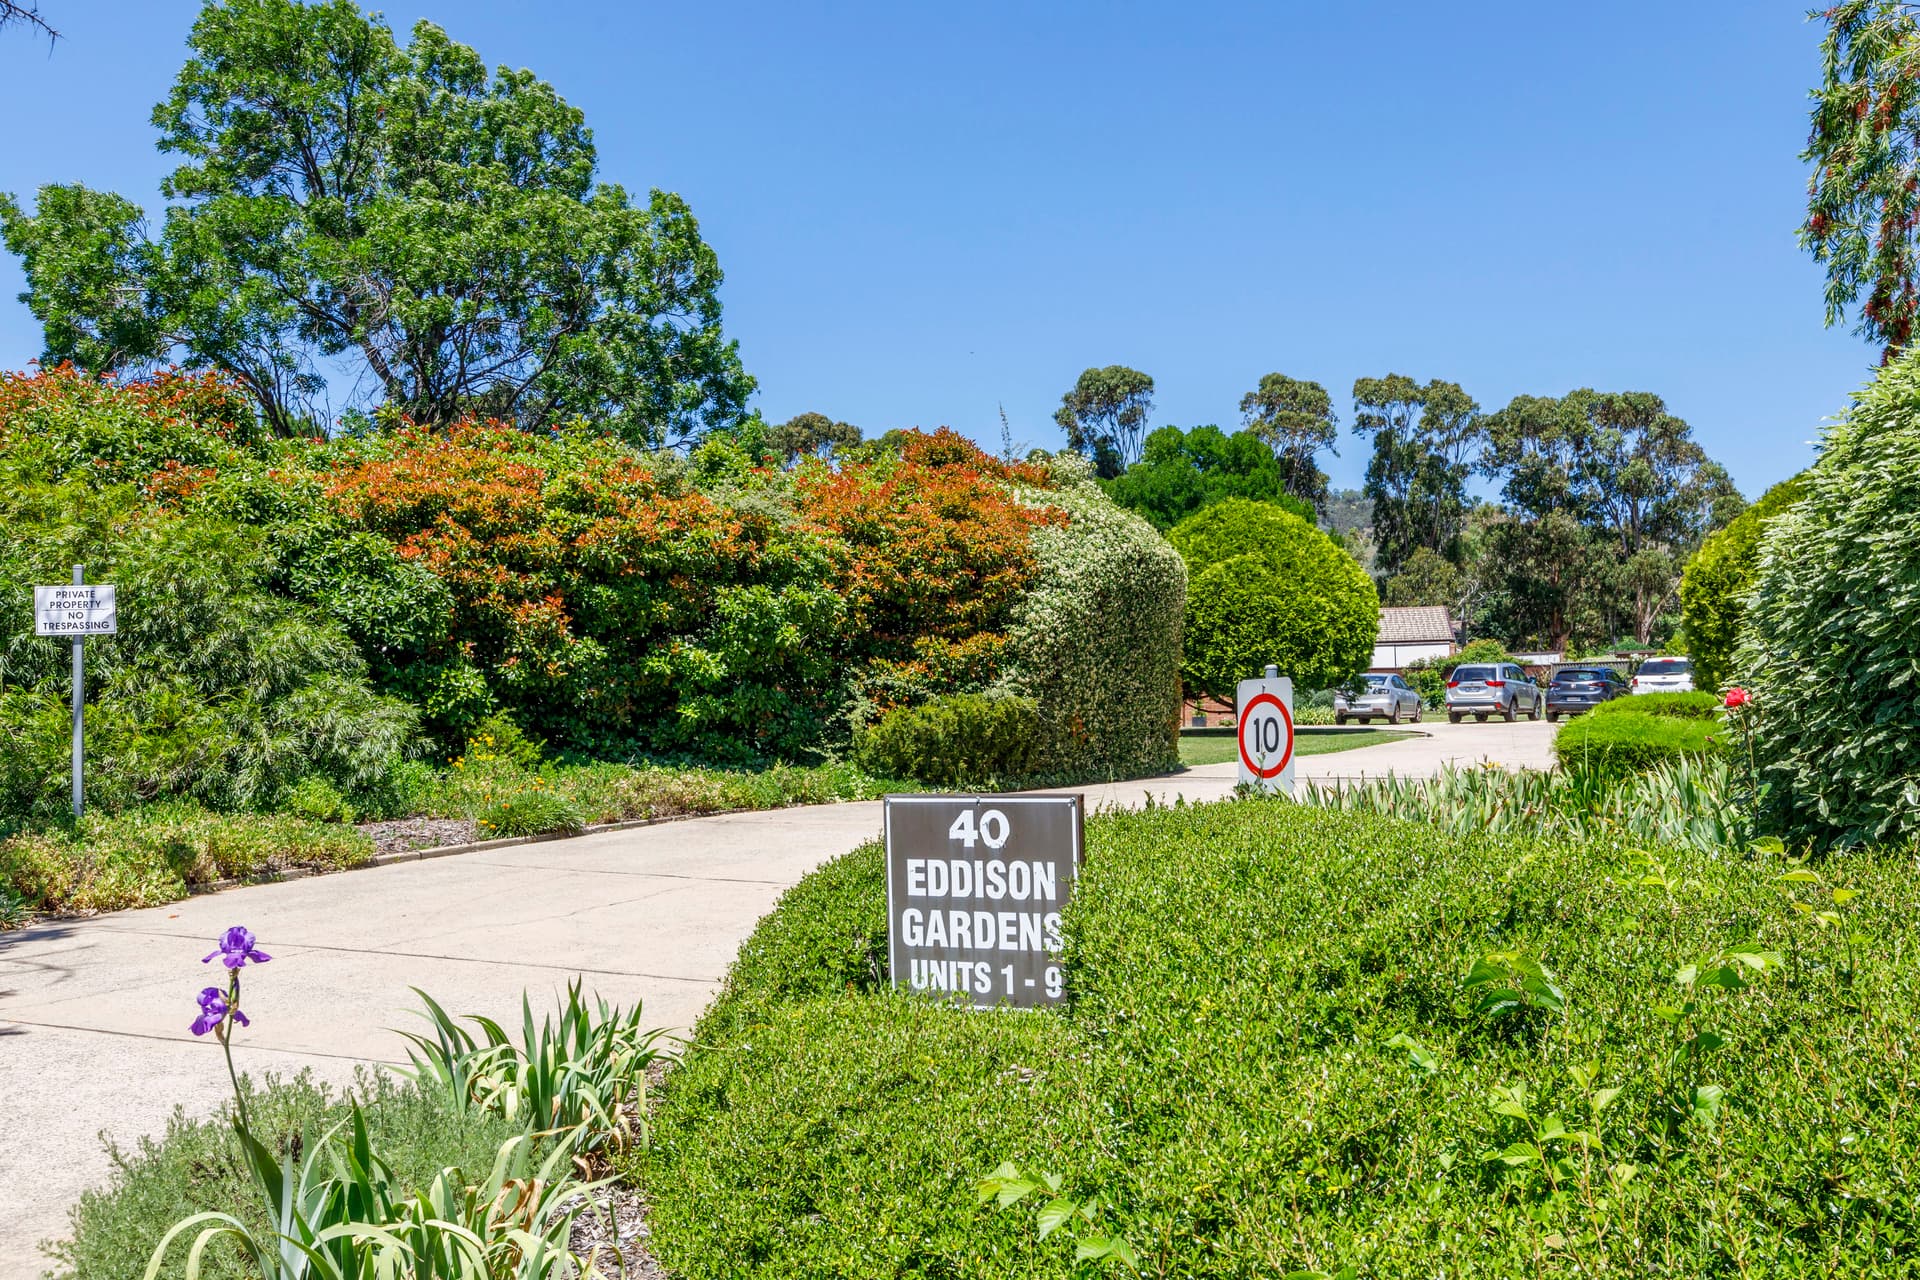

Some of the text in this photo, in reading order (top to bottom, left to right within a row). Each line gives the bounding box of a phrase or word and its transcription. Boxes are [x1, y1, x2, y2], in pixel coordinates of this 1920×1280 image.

[49, 600, 101, 609] PROPERTY
[55, 590, 96, 599] PRIVATE
[42, 621, 110, 630] TRESPASSING
[68, 611, 84, 620] NO
[1253, 716, 1280, 753] 10
[949, 809, 1011, 849] 40
[906, 858, 1057, 901] EDDISON
[902, 908, 1064, 952] GARDENS
[910, 959, 992, 994] UNITS
[1000, 964, 1015, 996] 1
[1044, 966, 1063, 998] 9
